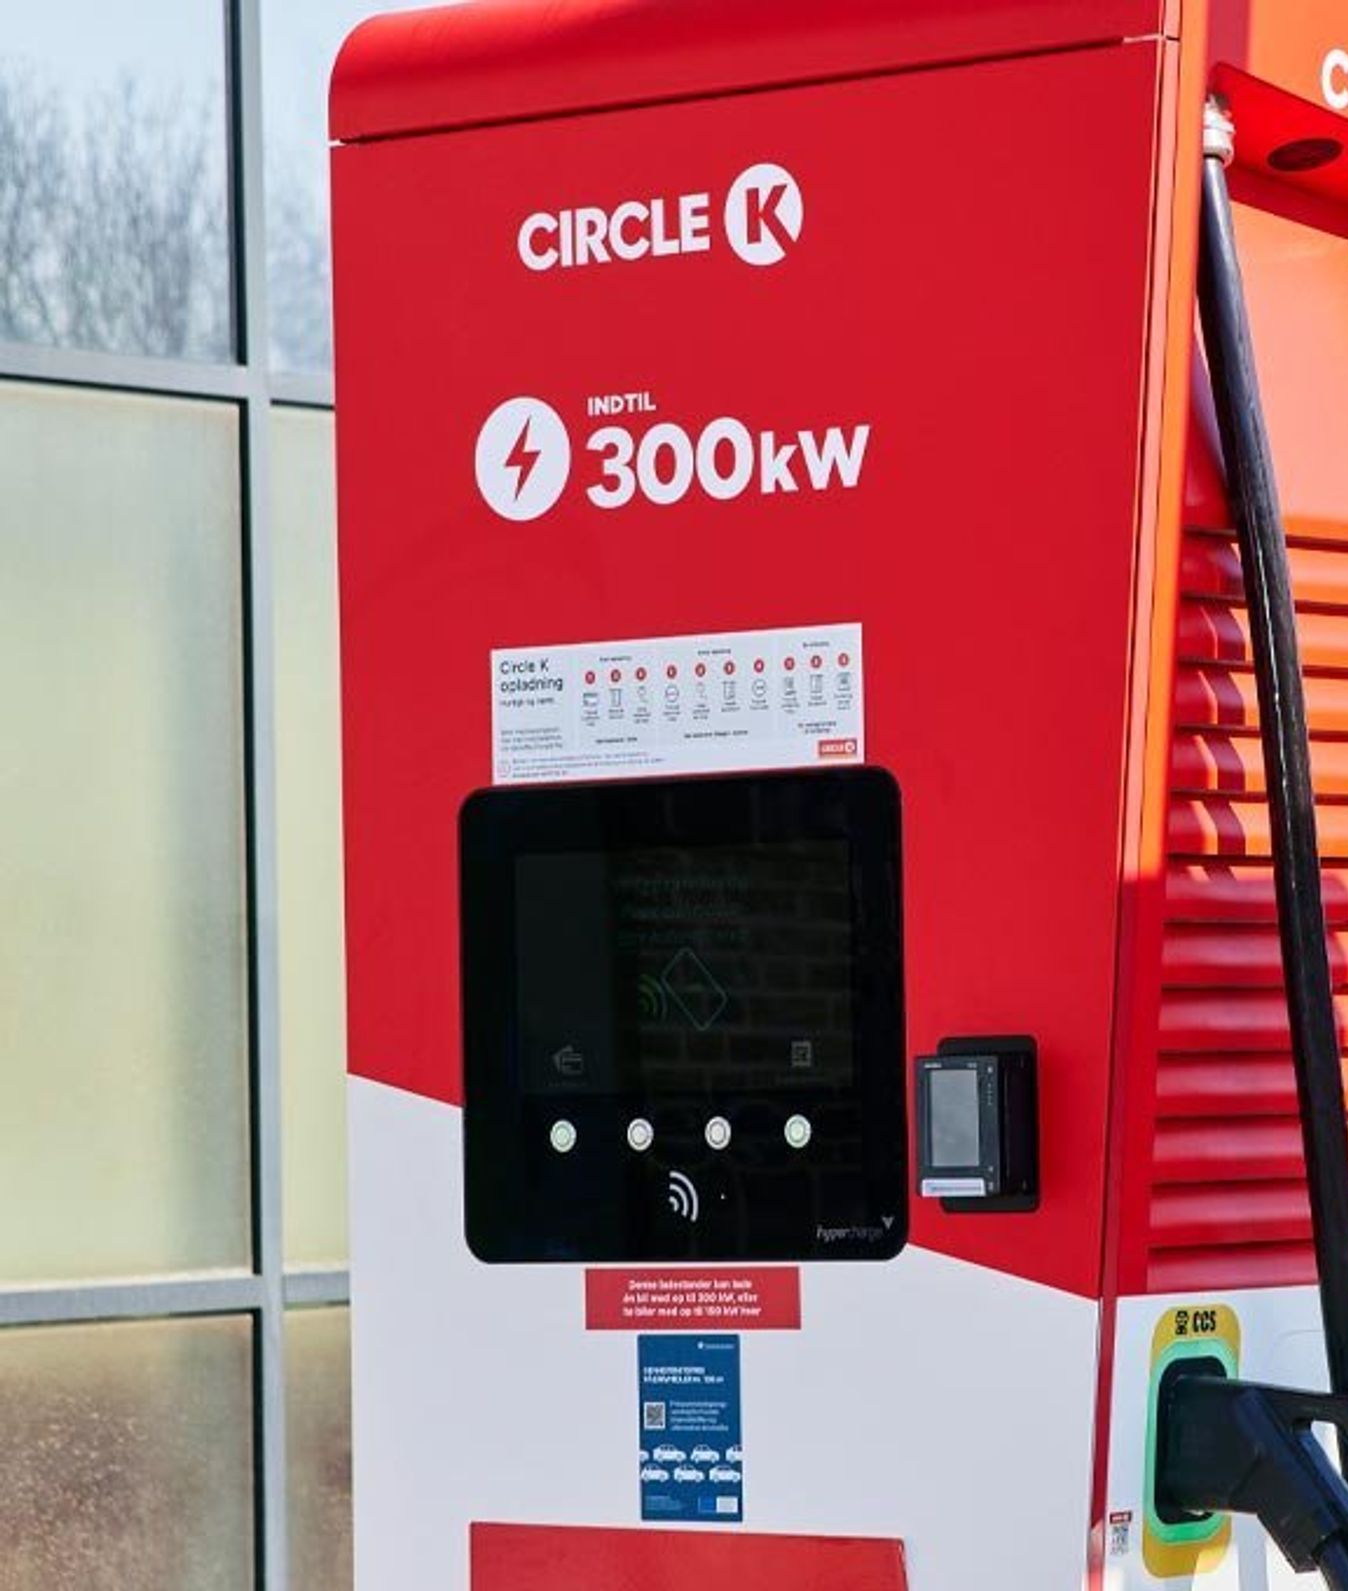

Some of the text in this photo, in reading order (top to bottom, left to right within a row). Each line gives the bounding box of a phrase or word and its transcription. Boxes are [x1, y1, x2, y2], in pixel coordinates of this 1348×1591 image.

[517, 192, 711, 271] CIRCLE
[587, 393, 657, 417] INDTIL
[500, 658, 549, 675] Circle K
[1193, 1310, 1217, 1333] CCS
